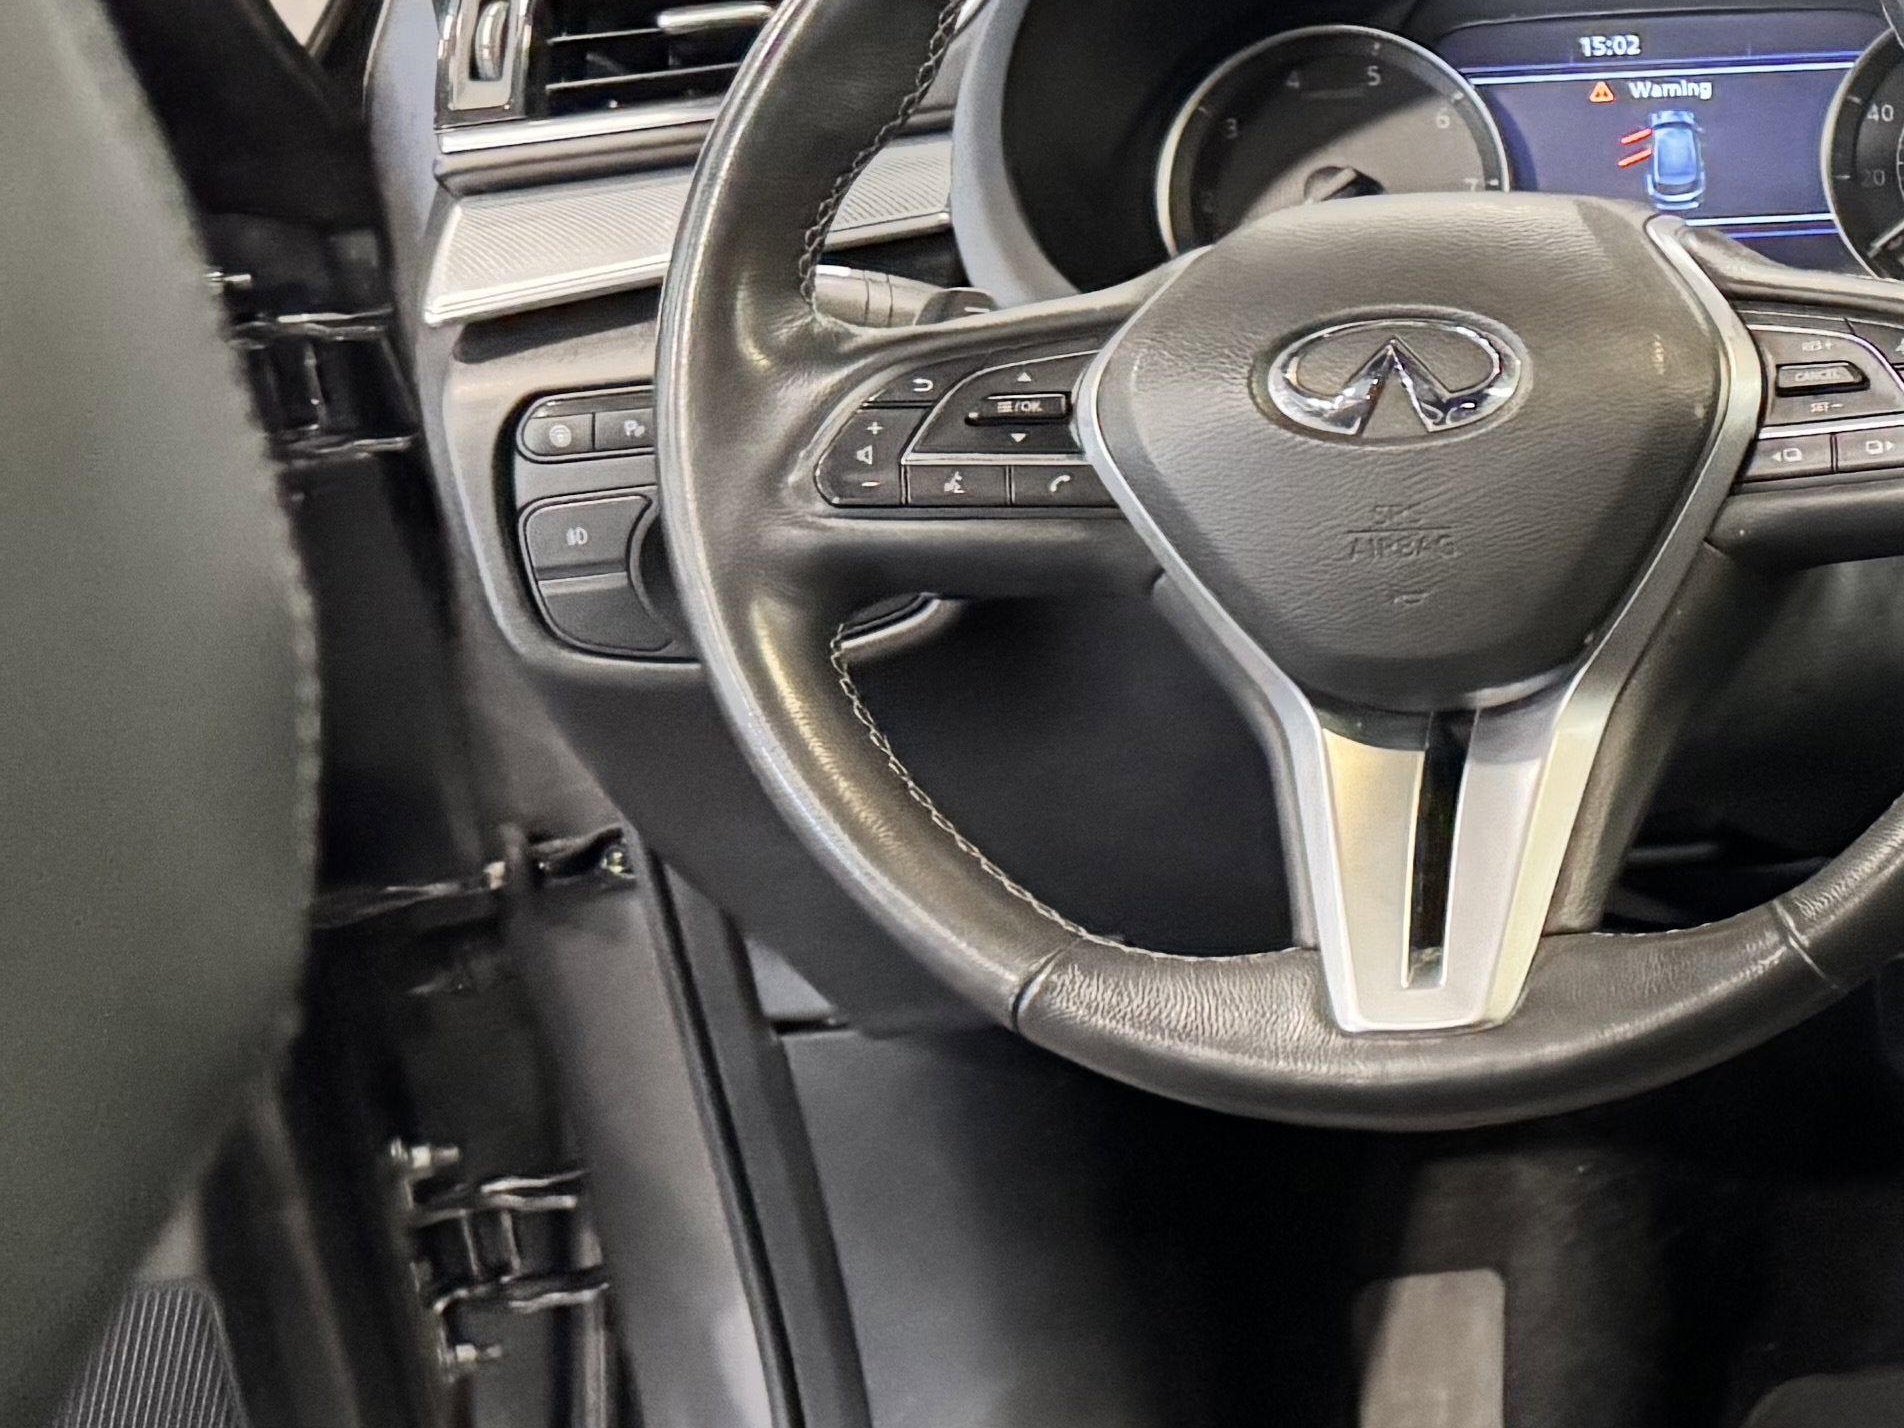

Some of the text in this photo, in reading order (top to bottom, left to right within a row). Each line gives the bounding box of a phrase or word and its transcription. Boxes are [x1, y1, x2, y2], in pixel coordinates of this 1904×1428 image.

[1579, 34, 1641, 57] 15:02
[1286, 71, 1300, 89] 4
[1367, 66, 1381, 86] 5
[1628, 79, 1712, 100] Warning
[1436, 110, 1450, 128] 6
[1867, 103, 1894, 122] 40
[1225, 118, 1238, 138] 3
